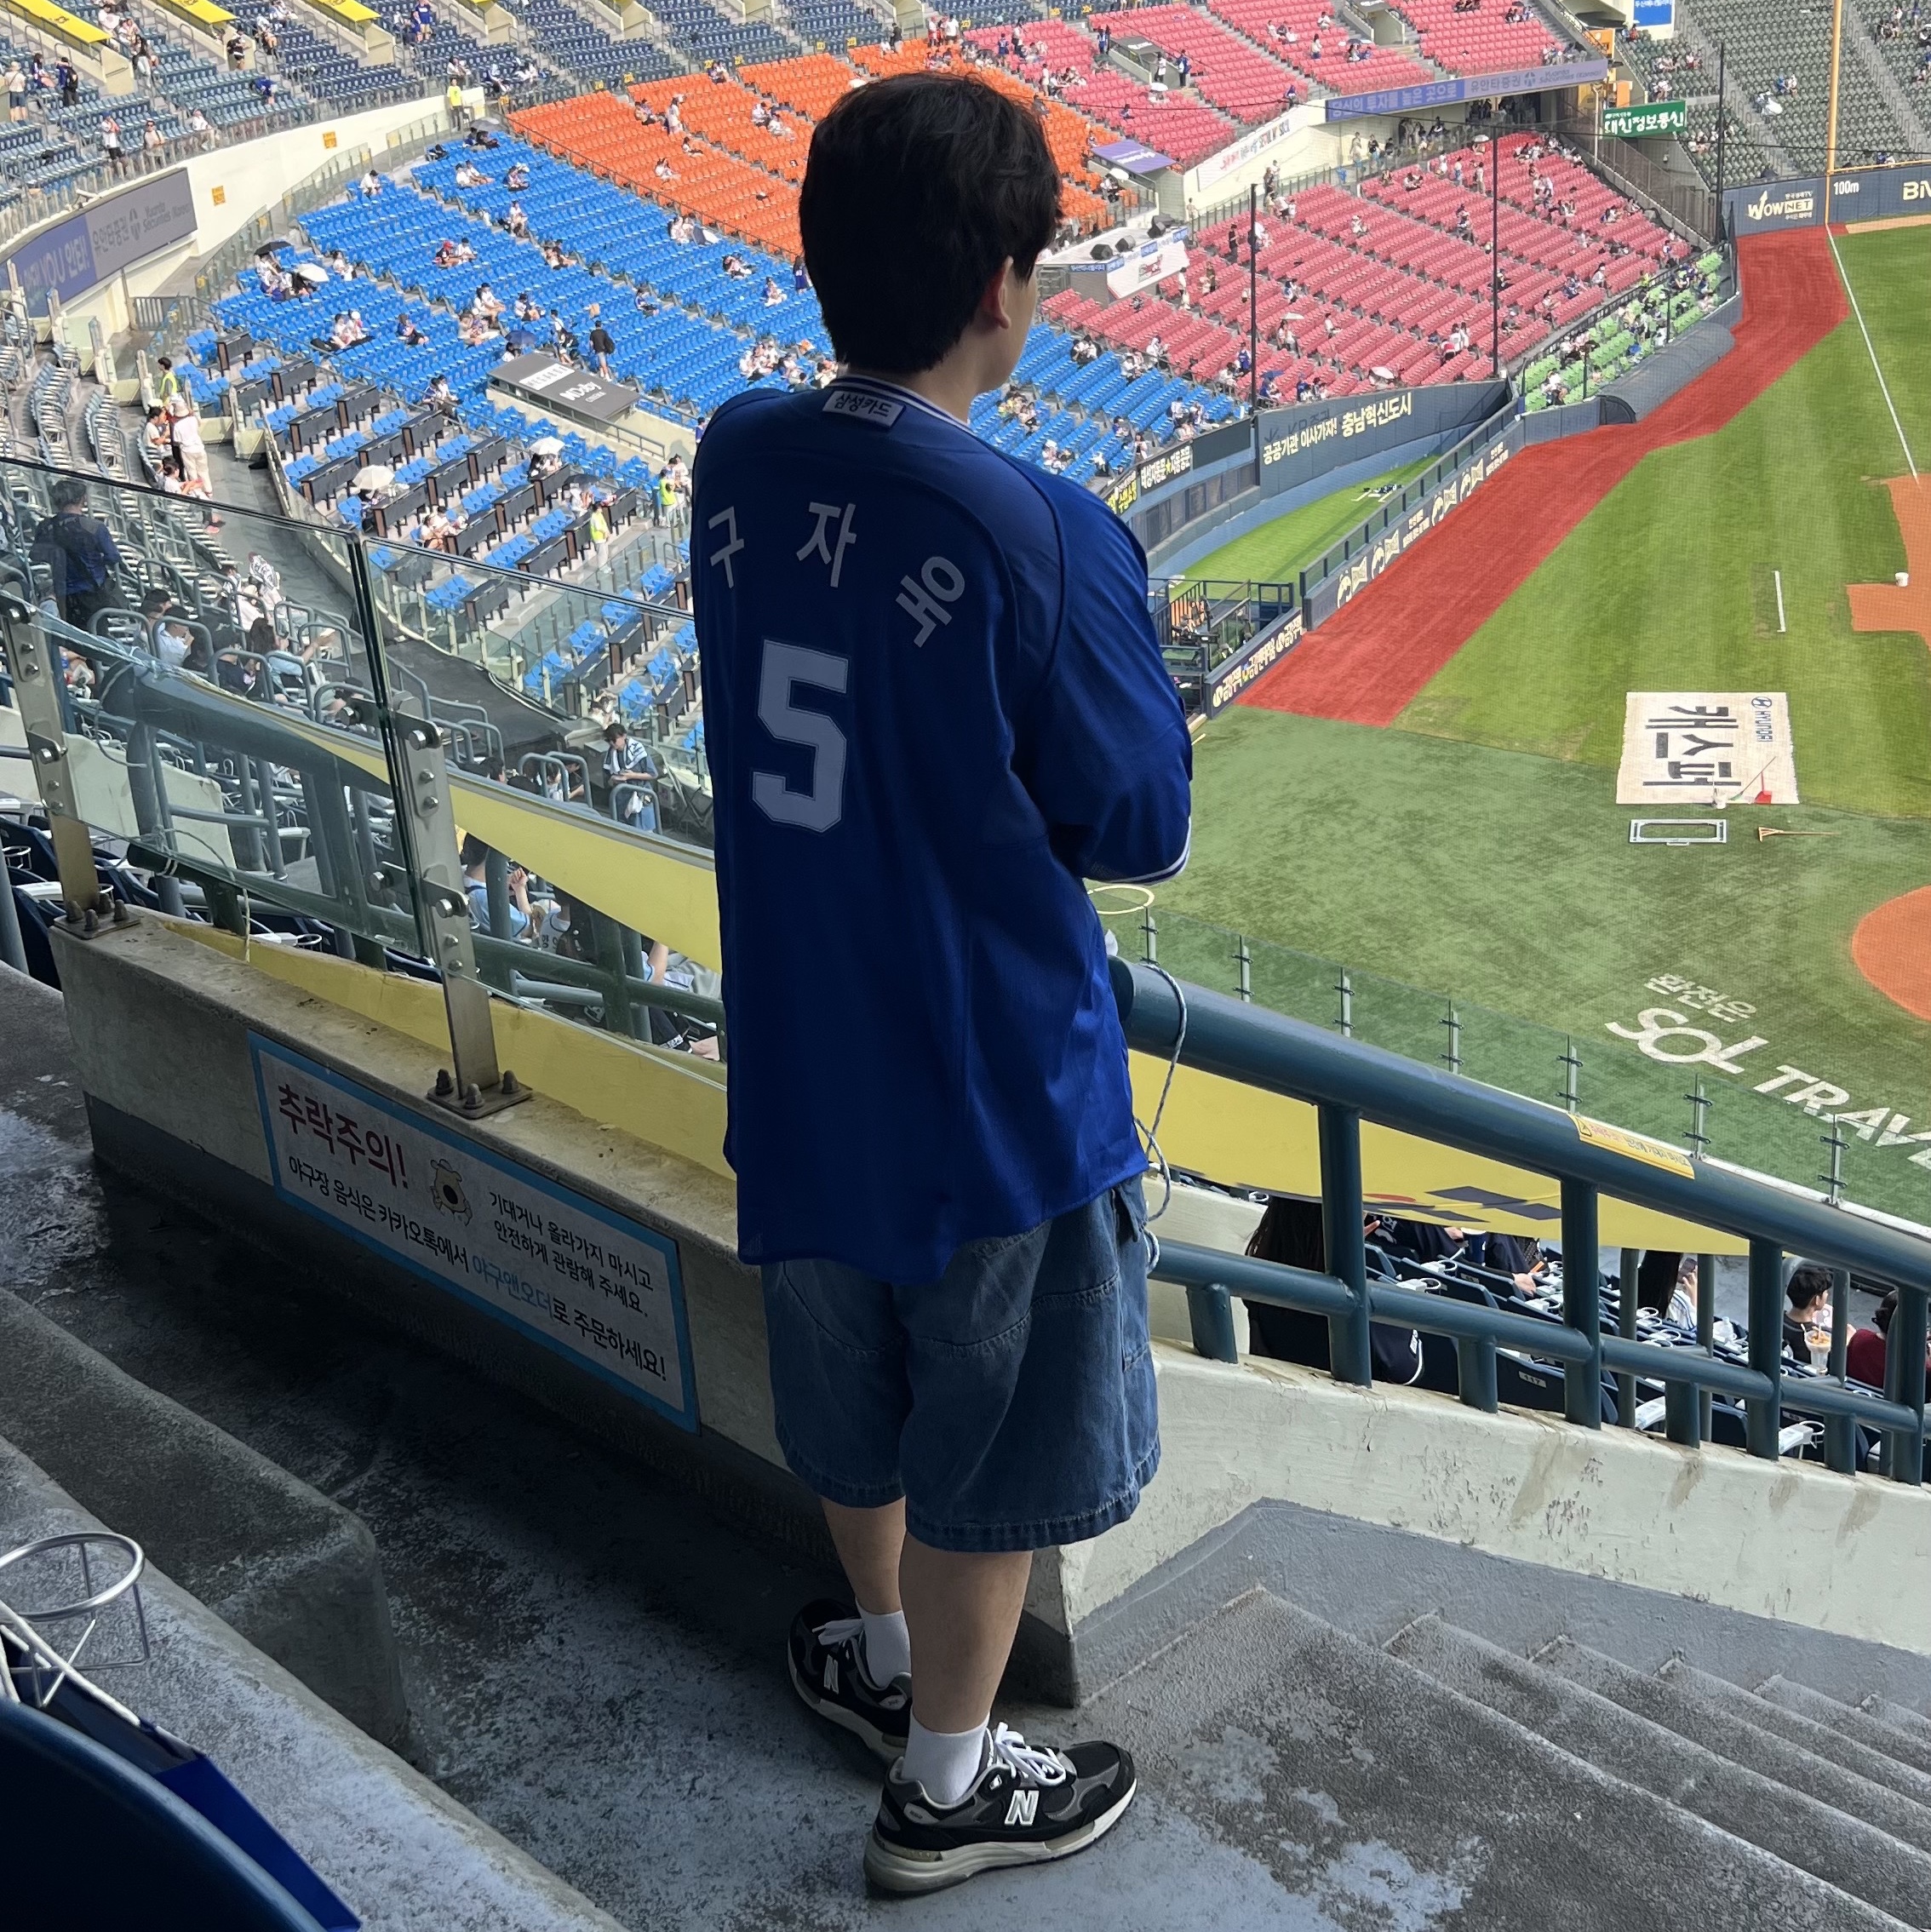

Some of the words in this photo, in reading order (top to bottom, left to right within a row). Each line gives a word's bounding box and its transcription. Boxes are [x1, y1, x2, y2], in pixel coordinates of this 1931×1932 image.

[1470, 76, 1521, 94] 유안타증권
[1604, 112, 1683, 135] 대신정보통신
[1833, 181, 1859, 196] 100m
[93, 217, 129, 255] 유안타증권
[834, 393, 891, 417] 삼성카드
[1263, 433, 1298, 465] 공공기관
[1301, 418, 1337, 447] 이사가자!
[1342, 393, 1412, 437] 충남혁신도시
[708, 502, 965, 647] 구자욱
[753, 639, 849, 833] 5
[1643, 706, 1741, 787] 캐스퍼
[1644, 972, 1757, 1023] 환전은
[1605, 1007, 1769, 1075] SOL
[1753, 1064, 1931, 1170] TRAV
[278, 1083, 409, 1190] 추락주의!
[289, 1155, 329, 1197] 야구장
[333, 1179, 376, 1223] 음식은
[379, 1204, 469, 1274] 카카오톡에서
[473, 1255, 570, 1326] 야구앤오더로
[574, 1309, 667, 1382] 주문하세요!
[490, 1192, 542, 1235] 기대거나
[547, 1221, 605, 1267] 올라가지
[608, 1253, 653, 1292] 마시고
[494, 1220, 548, 1265] 안전하게
[553, 1250, 594, 1291] 관람해
[599, 1275, 648, 1317] 주세요.
[823, 1654, 839, 1694] N
[1004, 1790, 1040, 1826] N
